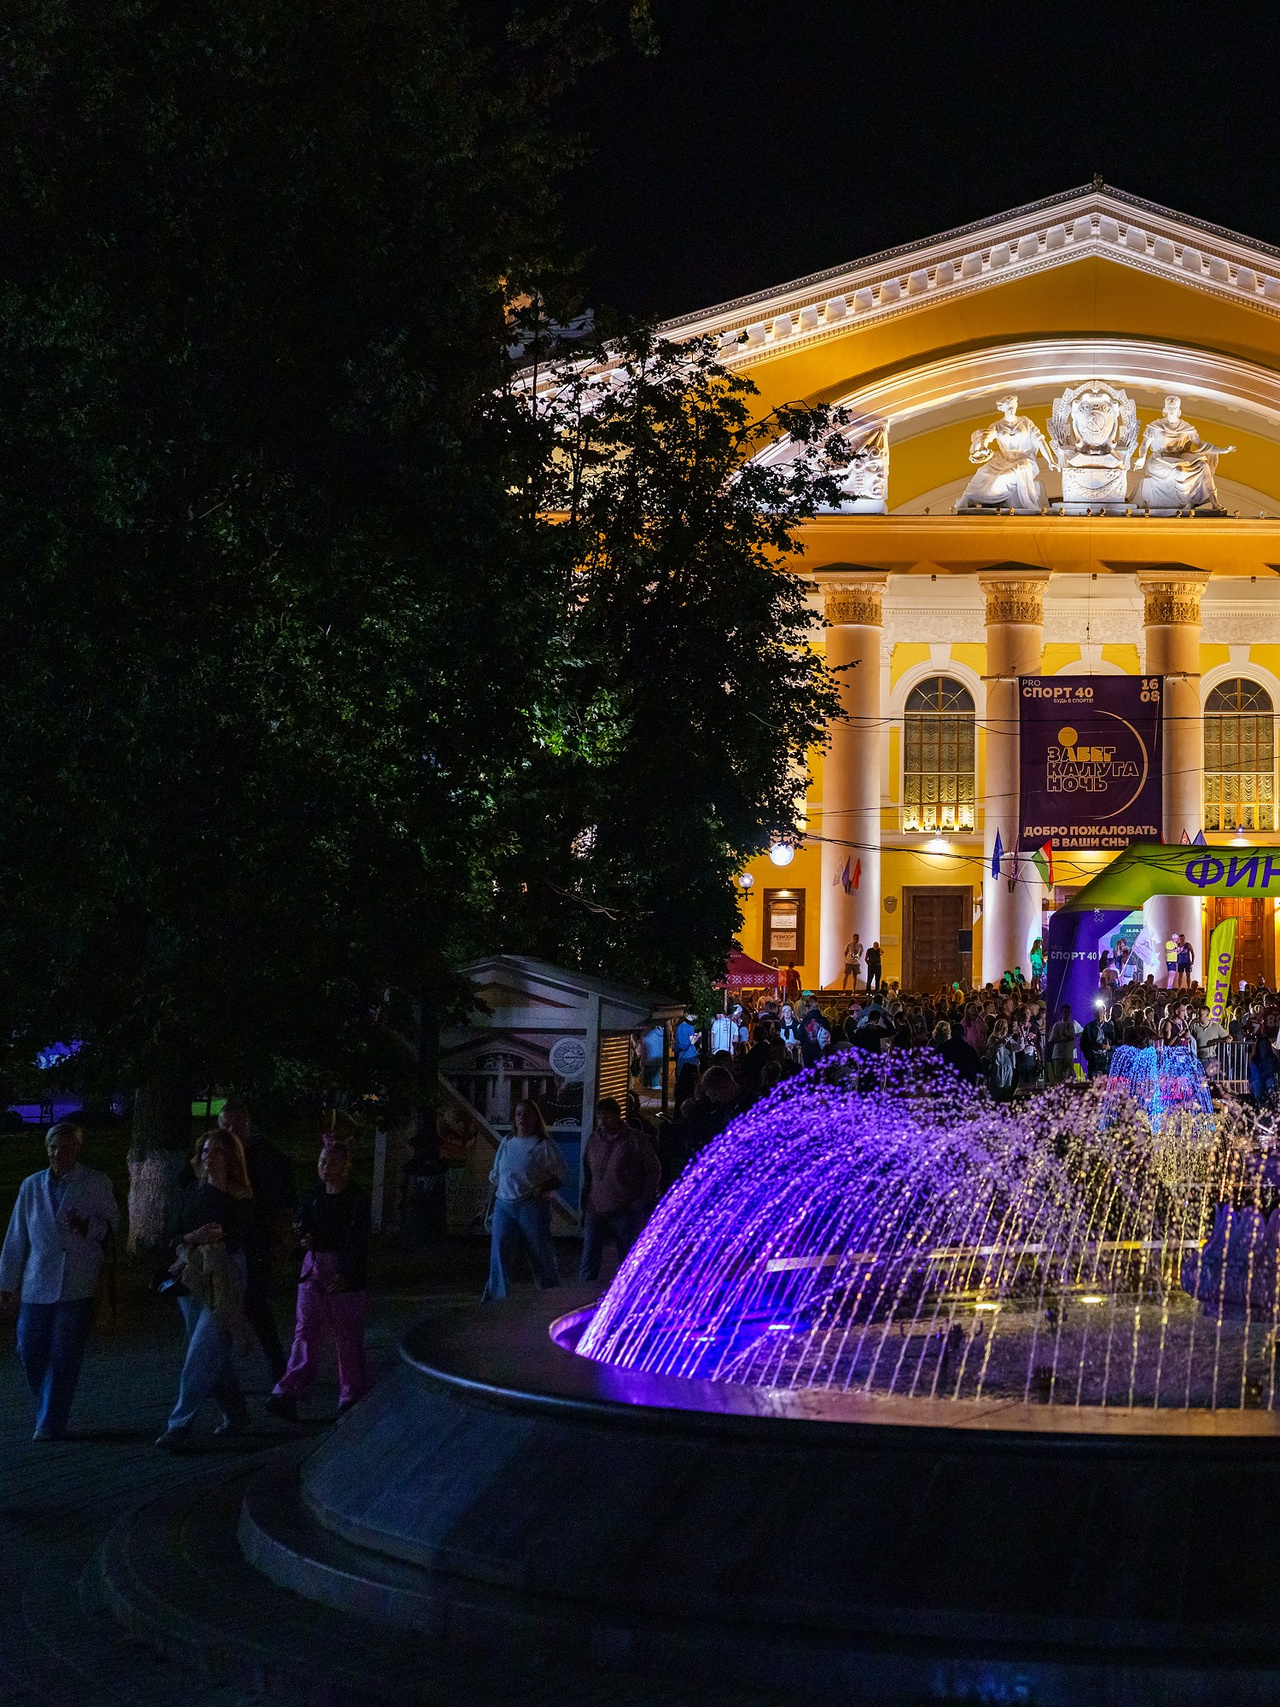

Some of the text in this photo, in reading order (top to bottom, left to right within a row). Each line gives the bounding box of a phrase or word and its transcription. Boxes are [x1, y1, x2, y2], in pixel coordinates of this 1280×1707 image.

[1022, 679, 1041, 687] PRO
[1141, 678, 1159, 690] 16
[1022, 687, 1094, 698] СПОРТ 40
[1140, 690, 1160, 703] 08
[1047, 746, 1117, 762] ЗАБЕГ
[1046, 761, 1140, 777] КАЛУГА
[1046, 776, 1108, 793] НОЧЬ
[1023, 825, 1158, 838] ДОБРО ПОЖАЛОВАТЬ
[1051, 837, 1130, 848] В ВАШИ СНЫ
[1050, 951, 1098, 961] СПОРТ 40
[1217, 952, 1231, 976] 40
